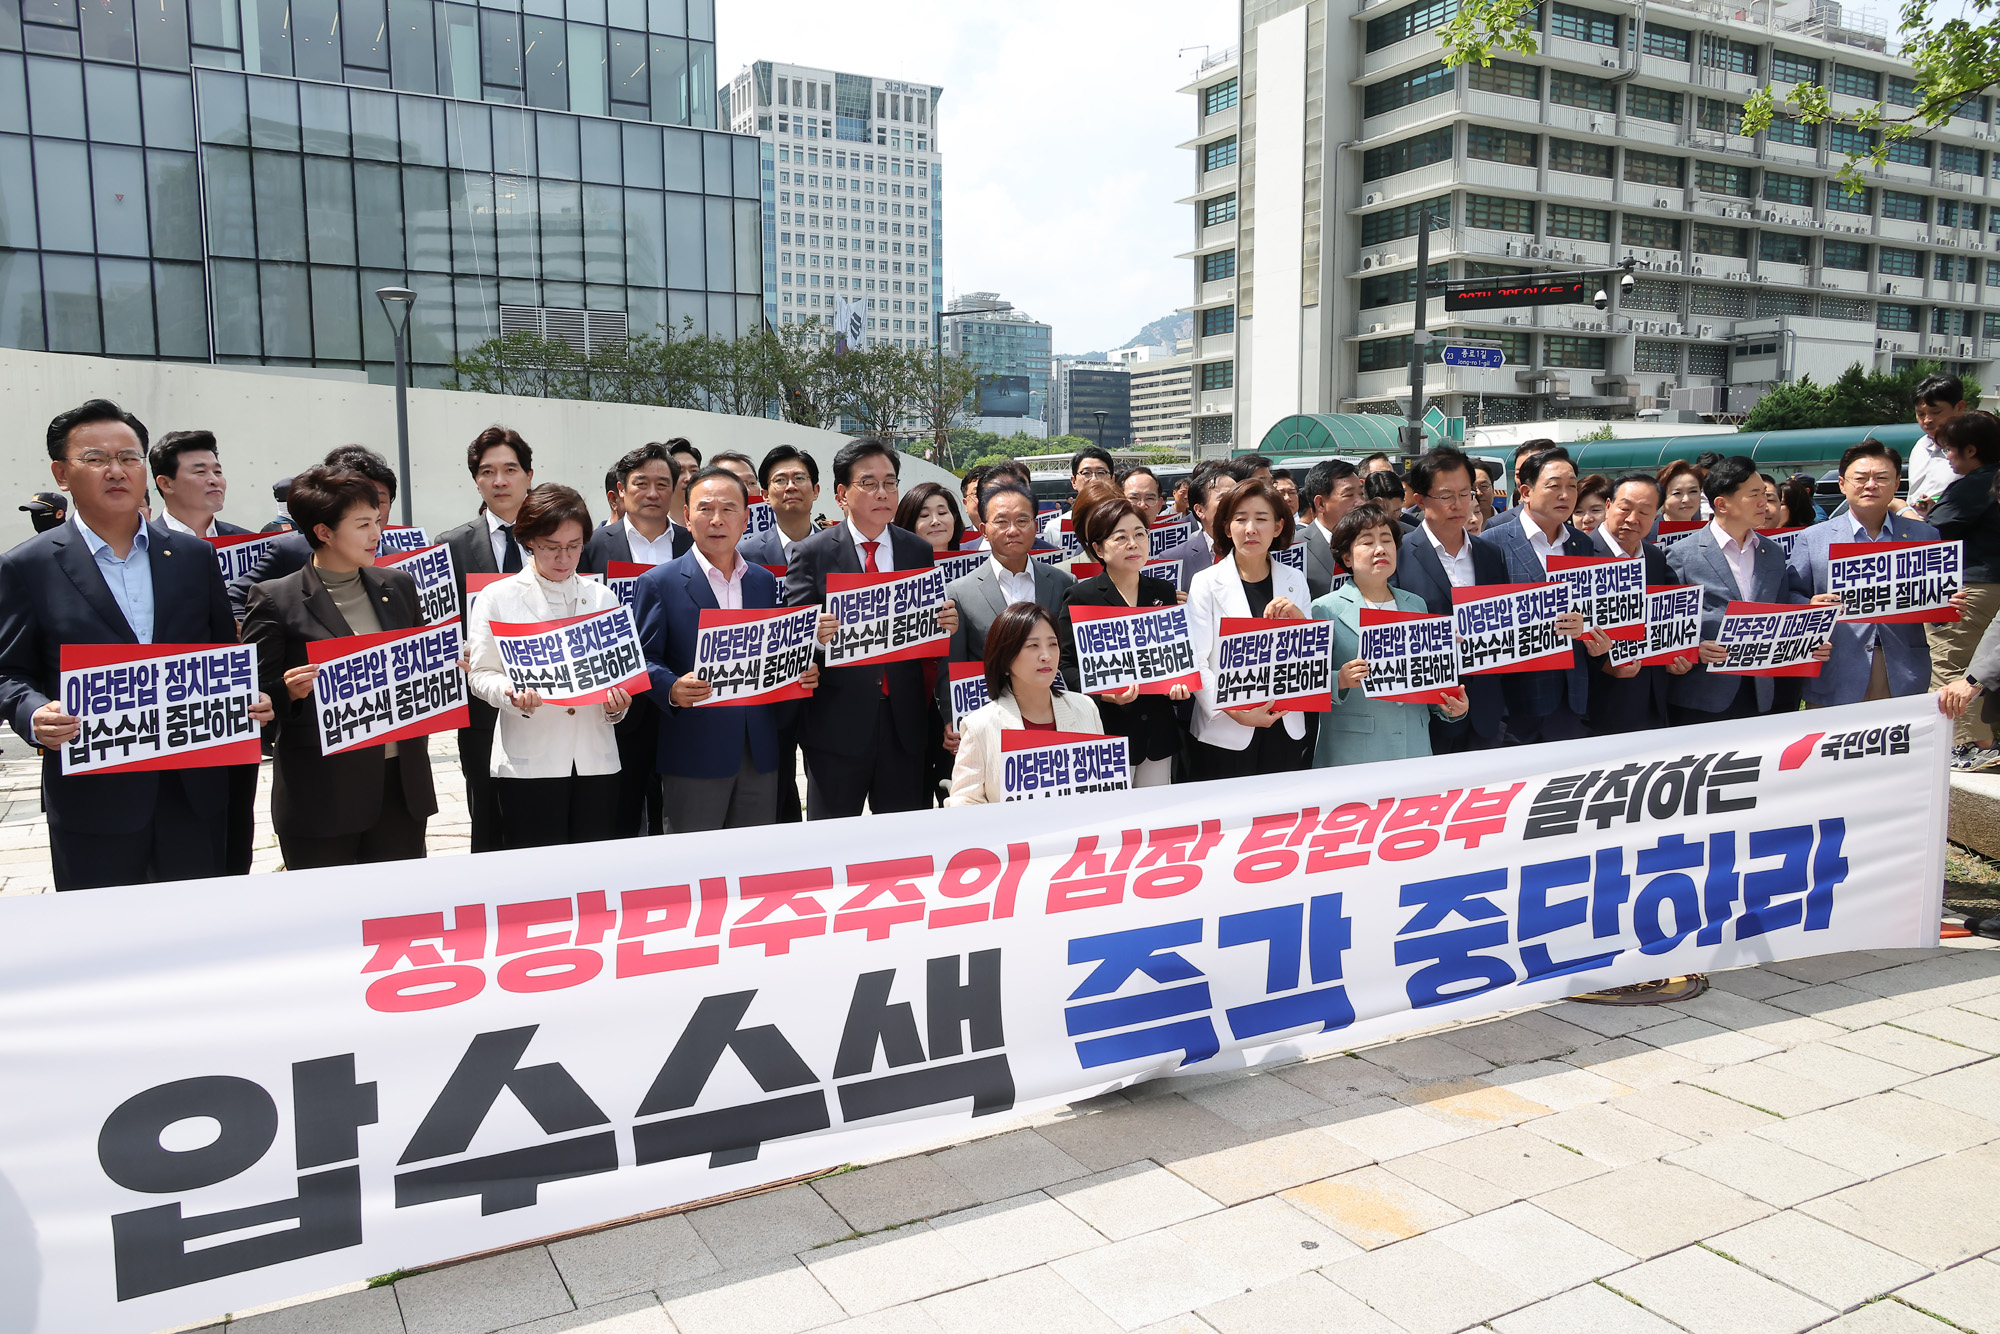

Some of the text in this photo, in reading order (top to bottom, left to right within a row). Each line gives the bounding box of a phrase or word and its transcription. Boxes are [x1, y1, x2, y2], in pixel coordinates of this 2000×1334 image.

[885, 81, 927, 95] 외교부 MOFA
[1446, 352, 1454, 360] 23
[1461, 349, 1487, 360] 종로1길
[1493, 355, 1501, 363] 27
[1595, 562, 1643, 596] 정치보복
[1832, 545, 1958, 589] 민주주의 파괴특검
[831, 586, 891, 626] 야당탄압
[894, 571, 946, 614] 정치보복
[1458, 597, 1514, 636] 야당탄압
[1516, 586, 1570, 625] 정치보복
[1596, 592, 1644, 626] 중단하라
[1651, 589, 1700, 622] 파괴특검
[1896, 576, 1958, 611] 절대사수
[500, 609, 634, 667] 야당탄압 정치보복
[700, 609, 818, 663] 야당탄압 정치보복
[830, 619, 889, 660] 압수수색
[1077, 608, 1189, 654] 야당탄압 정치보복
[1219, 625, 1330, 670] 야당탄압 정치보복
[1361, 620, 1453, 660] 야당탄압 정치보복
[1651, 618, 1697, 651] 절대사수
[1720, 609, 1837, 642] 민주주의 파괴특검
[318, 628, 459, 706] 야당탄압 정치보복
[509, 641, 642, 696] 압수수색 중단하라
[762, 643, 813, 688] 중단하라
[1082, 650, 1137, 688] 압수수색
[1137, 639, 1194, 679] 중단하라
[1410, 653, 1455, 688] 중단하라
[1460, 629, 1515, 669] 압수수색
[67, 649, 251, 717] 야당탄압 정치보복
[1216, 658, 1329, 704] 압수수색 중단하라
[69, 693, 254, 766] 압수수색 중단하라
[323, 666, 463, 748] 압수수색 중단하라
[1820, 723, 1911, 761] 국민의힘
[1005, 749, 1070, 792] 야당탄압
[1072, 741, 1127, 783] 정치보복
[360, 750, 1762, 1013] 정당민주주의 심장 당원명부 탈취하는
[97, 817, 1849, 1302] 압수수색 즉각 중단하라
